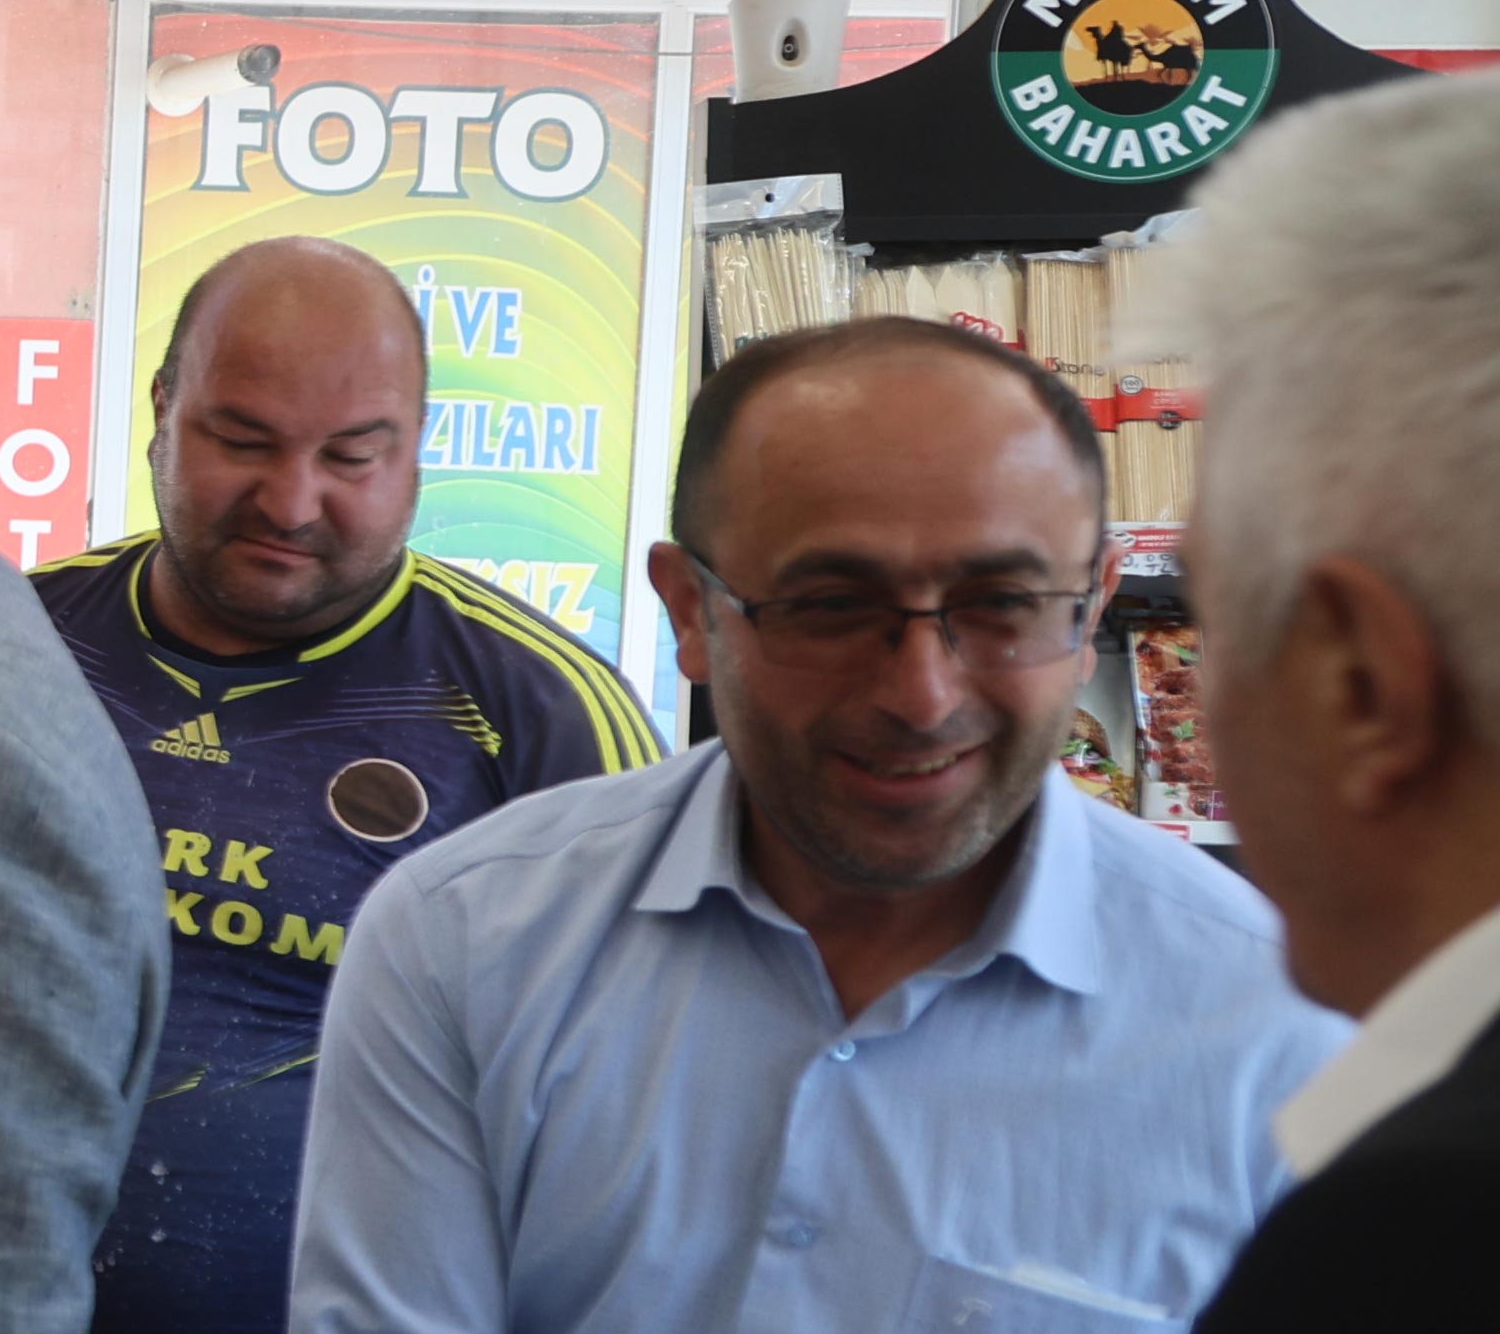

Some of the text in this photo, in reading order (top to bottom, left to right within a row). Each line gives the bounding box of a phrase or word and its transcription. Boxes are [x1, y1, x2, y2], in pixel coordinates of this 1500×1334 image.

[190, 79, 610, 204] FOTO
[1010, 74, 1249, 169] BAHARAT
[444, 283, 524, 360] VE
[420, 398, 603, 475] ZILARI
[149, 736, 232, 765] adidas
[163, 827, 275, 891] RK
[165, 886, 347, 967] KOM
